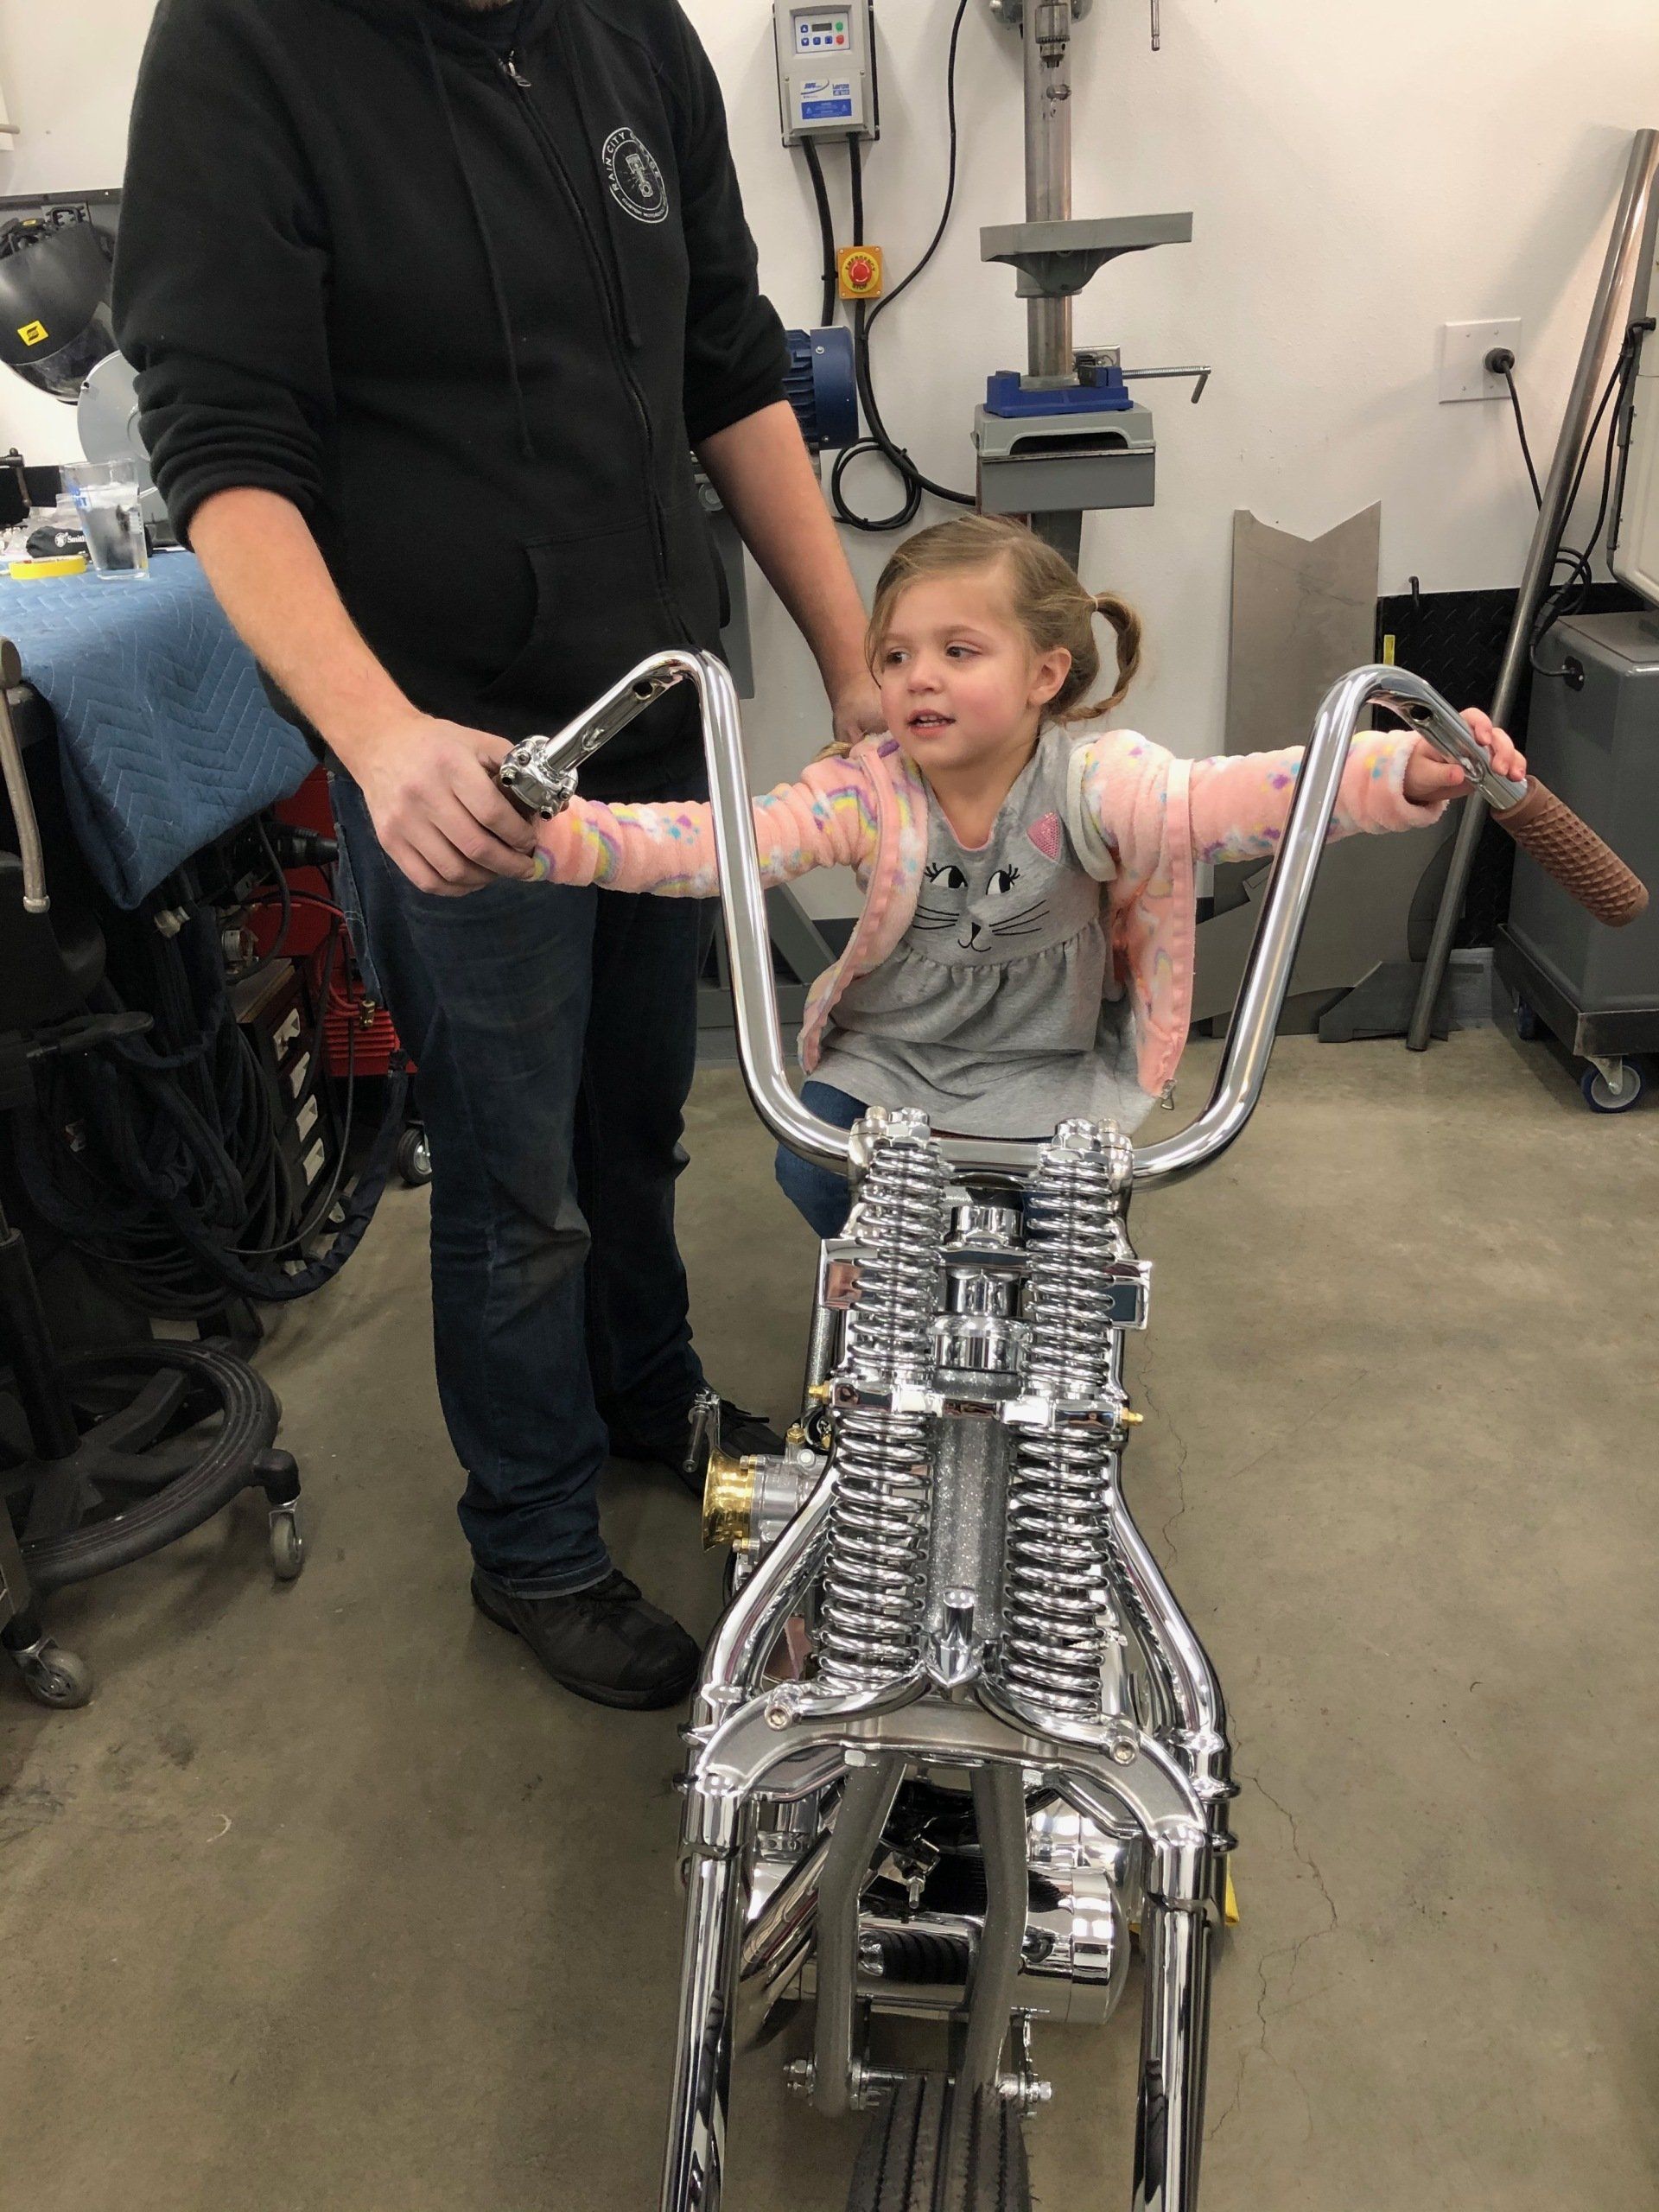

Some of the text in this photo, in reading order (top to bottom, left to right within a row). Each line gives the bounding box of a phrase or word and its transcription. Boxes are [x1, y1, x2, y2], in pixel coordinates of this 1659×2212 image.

[606, 131, 626, 191] RAIN CITY
[845, 255, 876, 271] EMERGENCY
